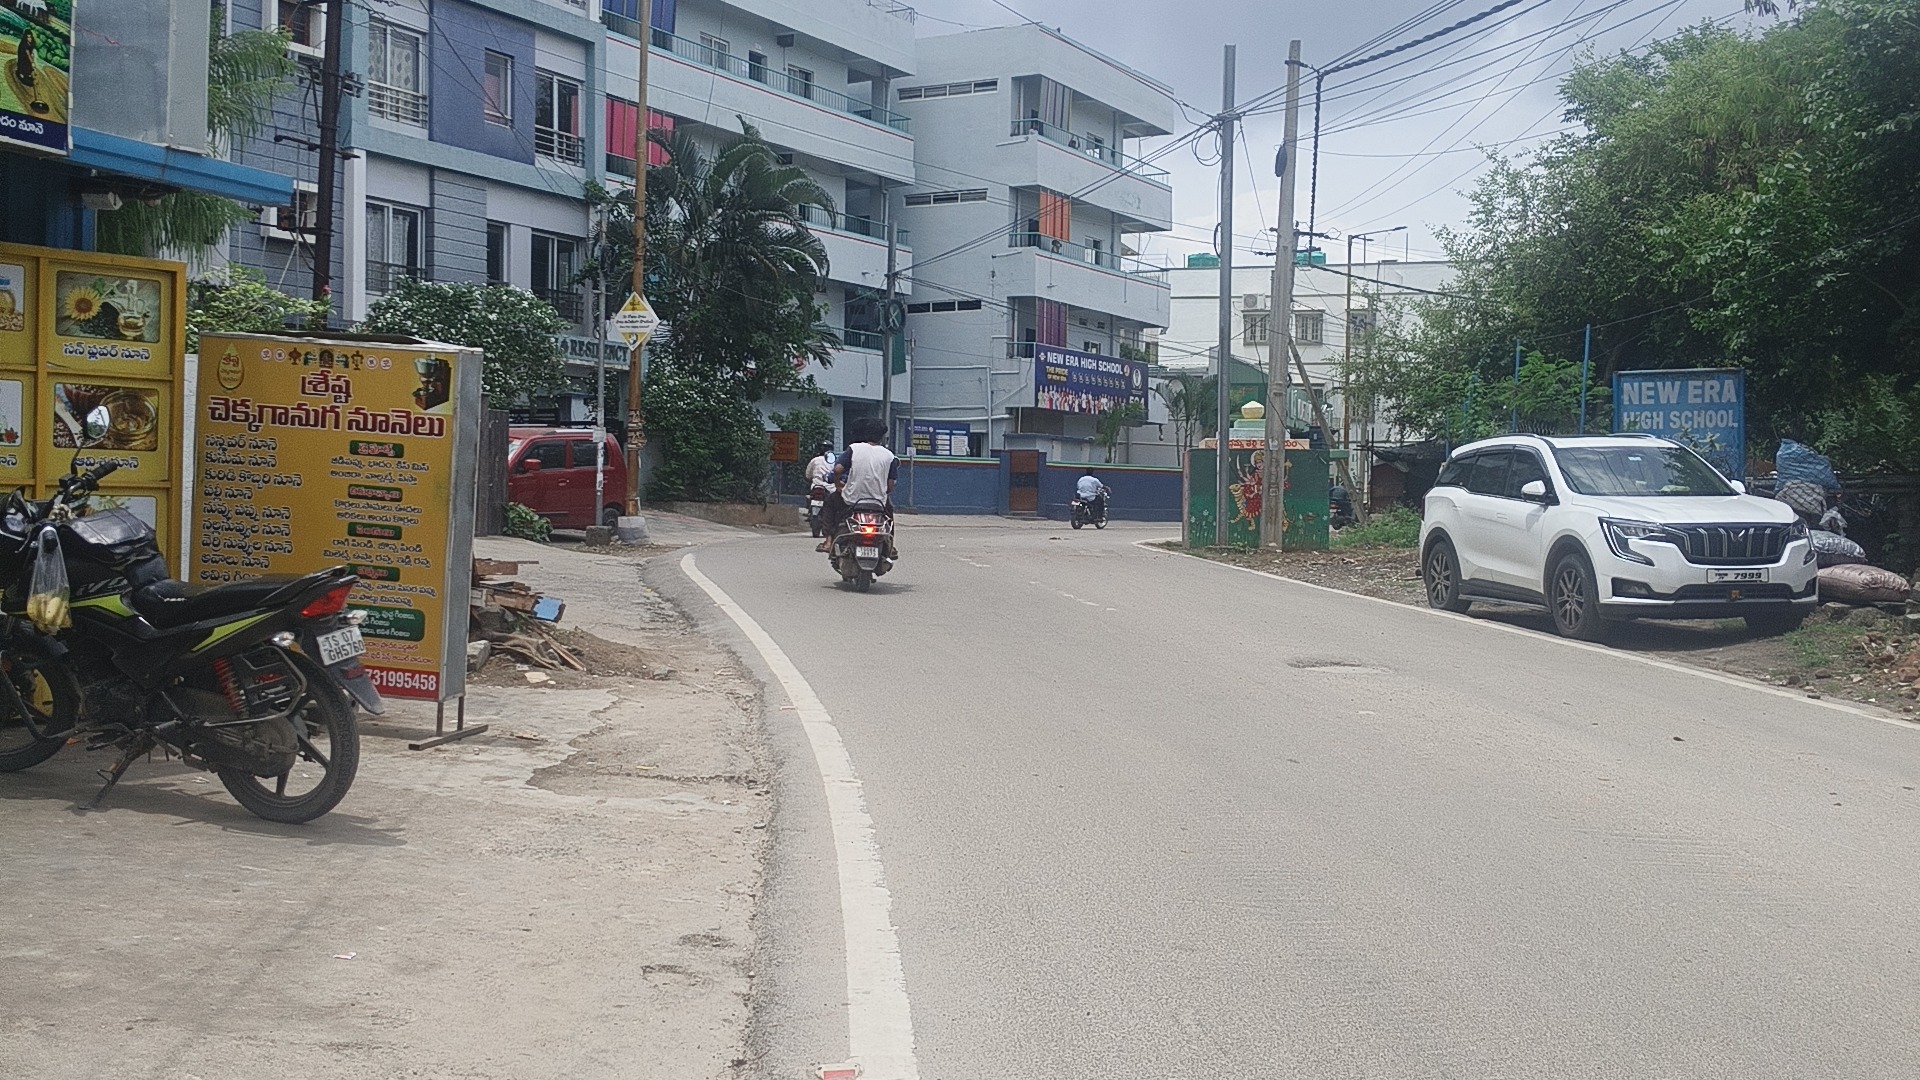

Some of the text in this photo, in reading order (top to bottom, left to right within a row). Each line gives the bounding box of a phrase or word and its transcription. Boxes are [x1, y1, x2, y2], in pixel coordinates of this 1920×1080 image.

[0, 115, 17, 128] దం
[64, 342, 85, 355] సన్
[120, 347, 150, 360] నూనె
[1047, 351, 1124, 375] NEW ERA HIGH SCHOOL
[1623, 379, 1737, 405] NEW ERA
[207, 395, 446, 437] చెక్కగానుగ నూనెలు
[1623, 409, 1739, 430] HIGH SCHOOL
[248, 437, 278, 451] నూనె
[205, 450, 277, 468] కుసుమ నూనె
[273, 472, 302, 487] నూనె
[224, 486, 253, 500] నూనె
[262, 505, 291, 519] నూనె
[262, 522, 291, 537] నూనె
[264, 539, 294, 554] నూనె
[241, 555, 270, 568] నూనె
[1733, 572, 1762, 580] 7999
[323, 635, 341, 649] TS
[341, 629, 354, 642] 07
[328, 639, 365, 661] GH5760
